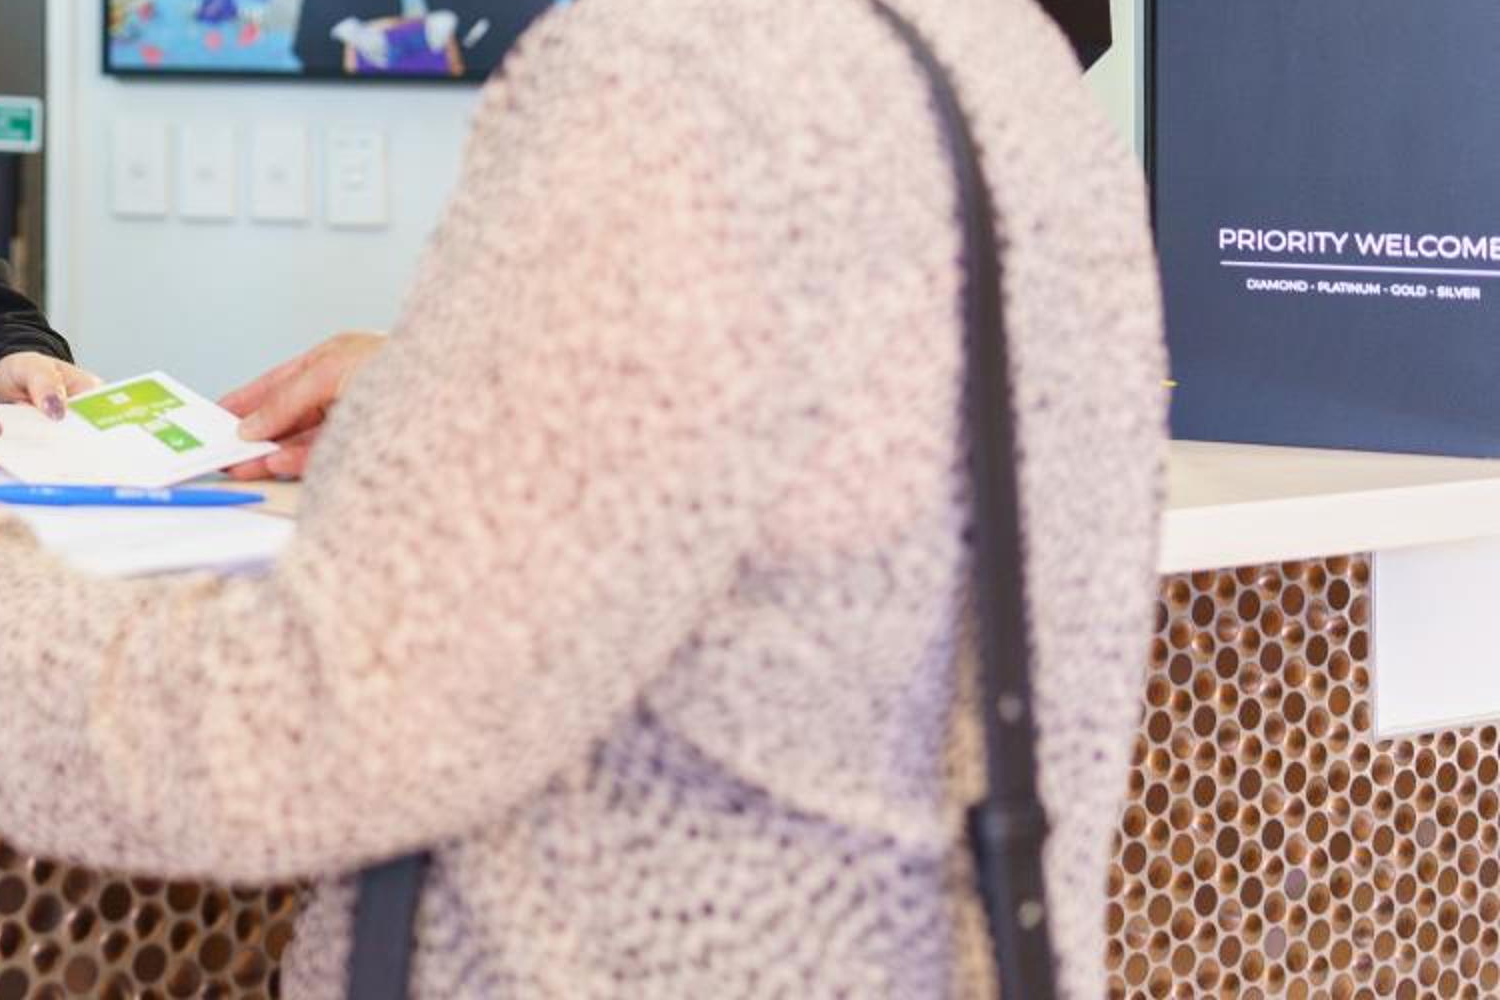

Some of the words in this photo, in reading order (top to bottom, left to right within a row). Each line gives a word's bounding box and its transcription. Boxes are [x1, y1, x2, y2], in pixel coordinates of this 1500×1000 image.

[1219, 228, 1348, 254] PRIORITY
[1354, 233, 1500, 261] WELCOME
[1246, 278, 1308, 292] DIAMOND
[1317, 280, 1381, 296] PLATINUM
[1390, 283, 1427, 298] GOLD
[1436, 285, 1481, 300] SILVER
